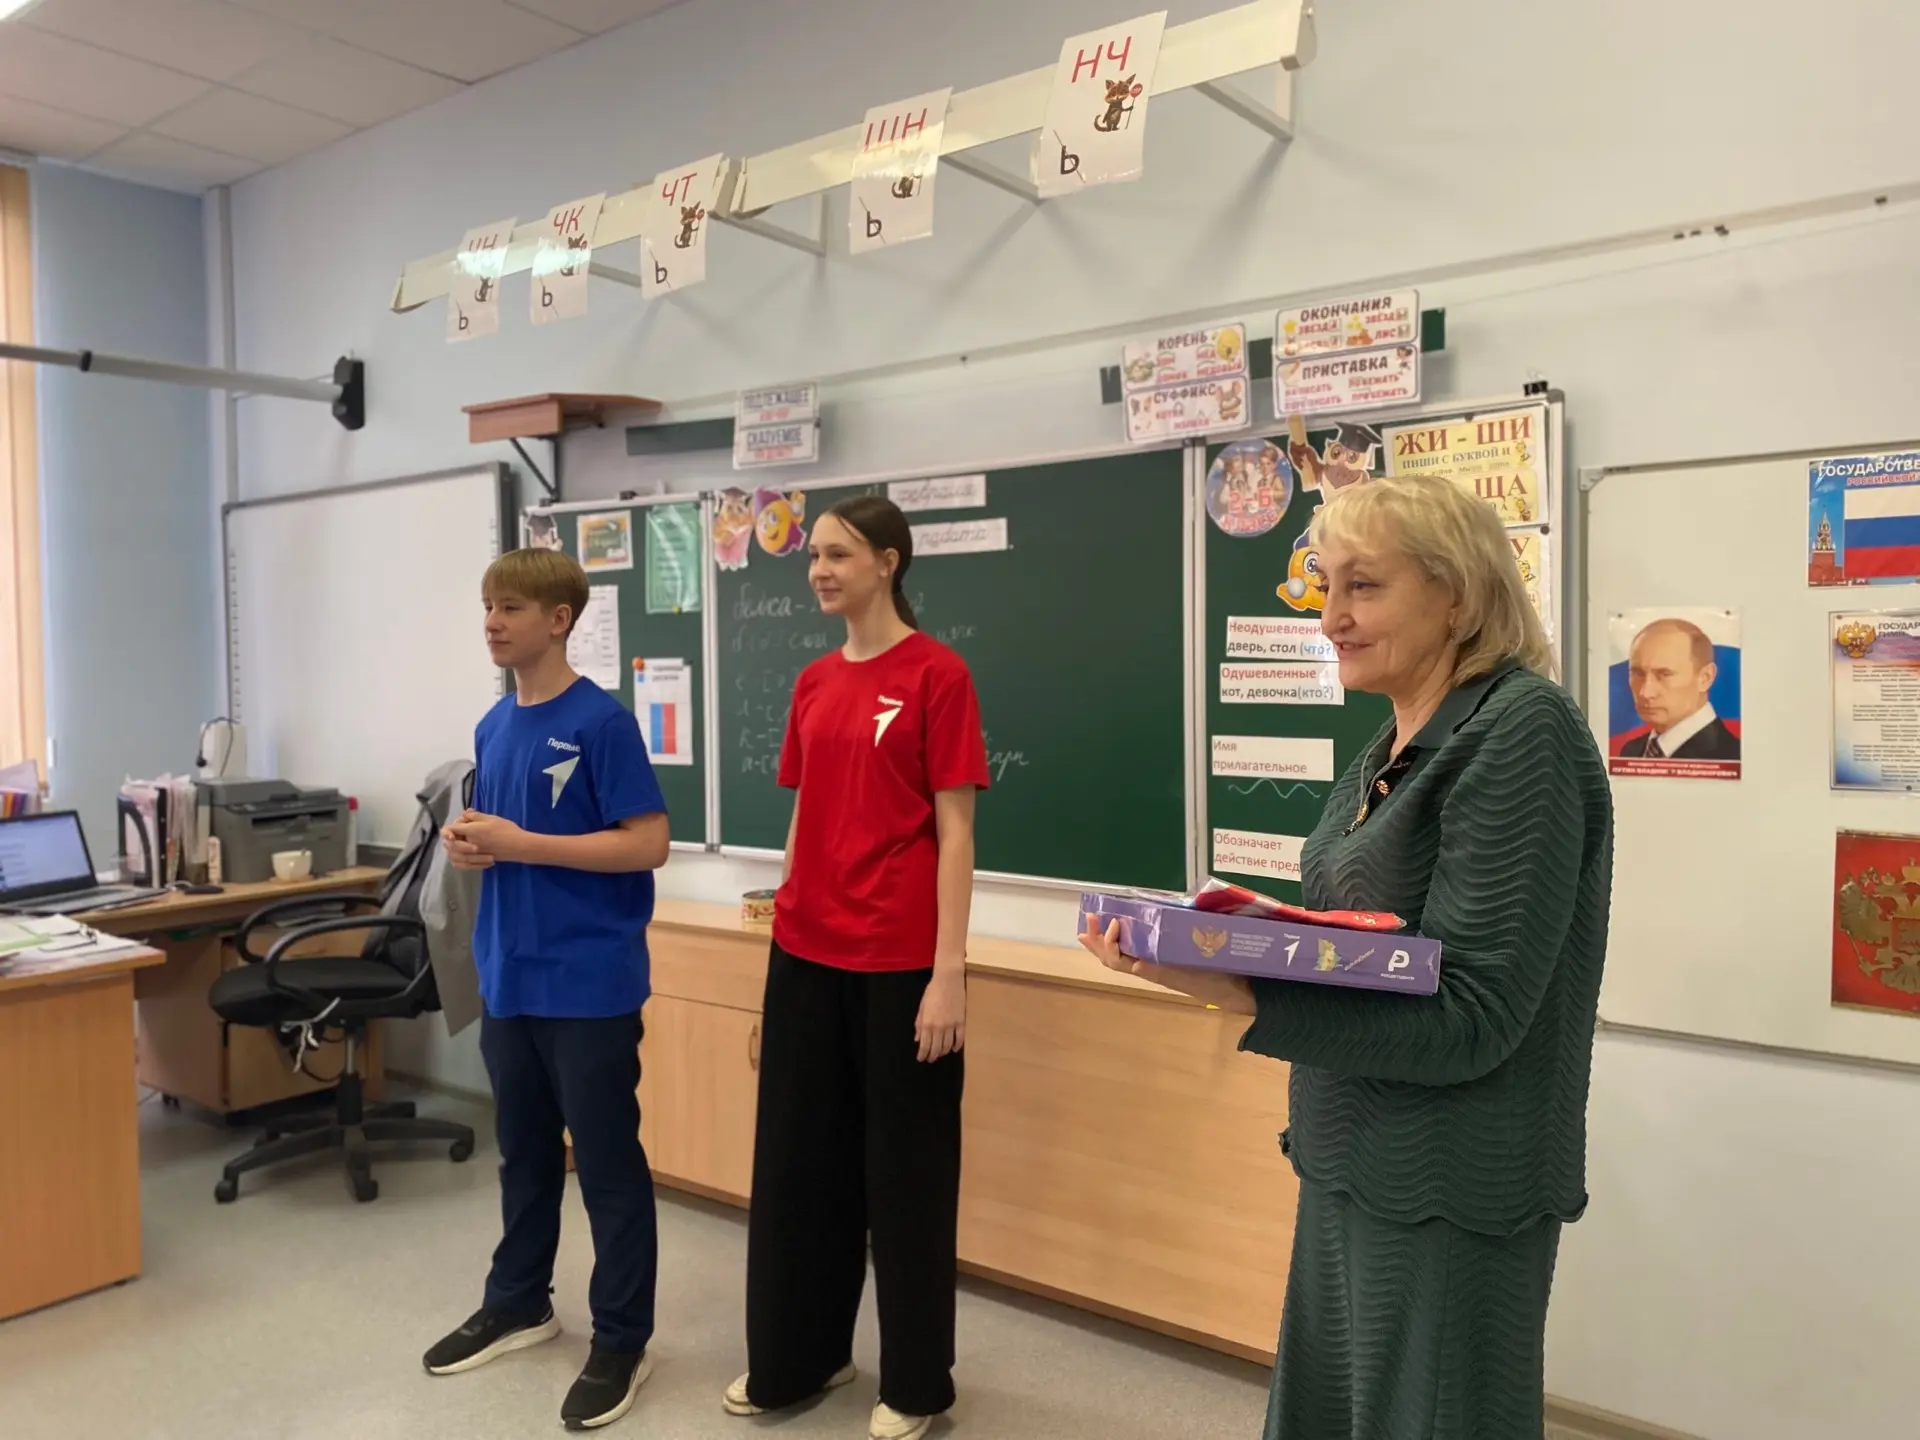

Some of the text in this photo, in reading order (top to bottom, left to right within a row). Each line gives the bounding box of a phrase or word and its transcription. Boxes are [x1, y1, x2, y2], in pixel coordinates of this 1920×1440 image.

[1300, 296, 1392, 323] ОКОНЧАНИЯ
[1158, 331, 1208, 350] КОРЕНЬ
[1302, 356, 1388, 380] ПРИСТАВКА
[1154, 383, 1216, 404] СУФФИКС
[1395, 429, 1448, 456] ЖИ
[1477, 416, 1531, 445] ШИ
[1402, 446, 1511, 469] ПИШИ С БУКВОЙ И
[1475, 474, 1528, 501] ЩА
[1227, 642, 1267, 654] дверь,
[1269, 644, 1296, 653] стол
[1221, 667, 1316, 680] Одушевленные
[1222, 688, 1244, 699] кот,
[547, 737, 581, 752] Первые
[1213, 740, 1237, 752] Имя
[1213, 760, 1307, 774] прилагательное
[1214, 833, 1282, 850] Обозначает
[1215, 852, 1267, 868] действие
